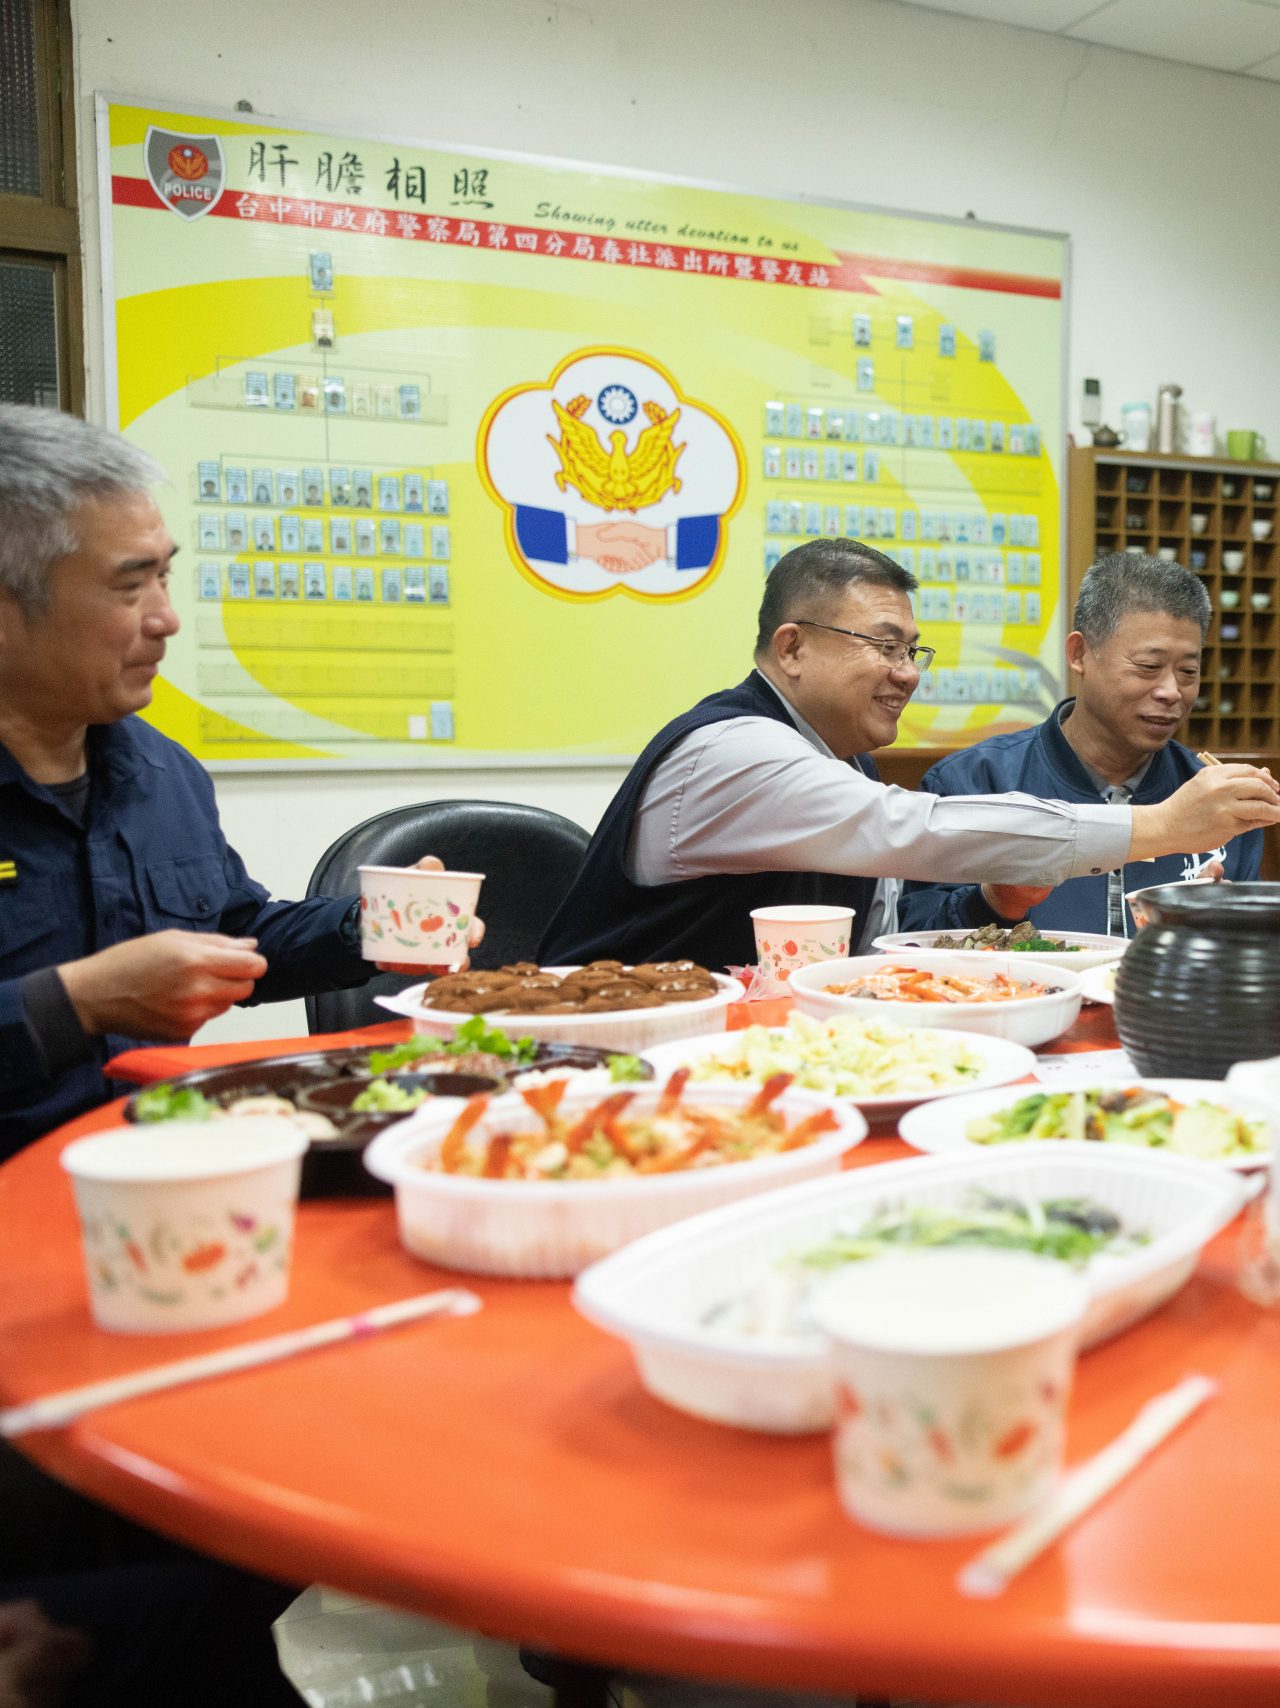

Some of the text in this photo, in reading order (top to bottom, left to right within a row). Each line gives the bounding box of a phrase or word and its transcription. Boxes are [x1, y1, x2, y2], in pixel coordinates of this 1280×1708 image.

[163, 182, 212, 201] POLICE
[248, 141, 494, 210] 肝膽相照
[534, 202, 800, 252] Showing utter devotion to us
